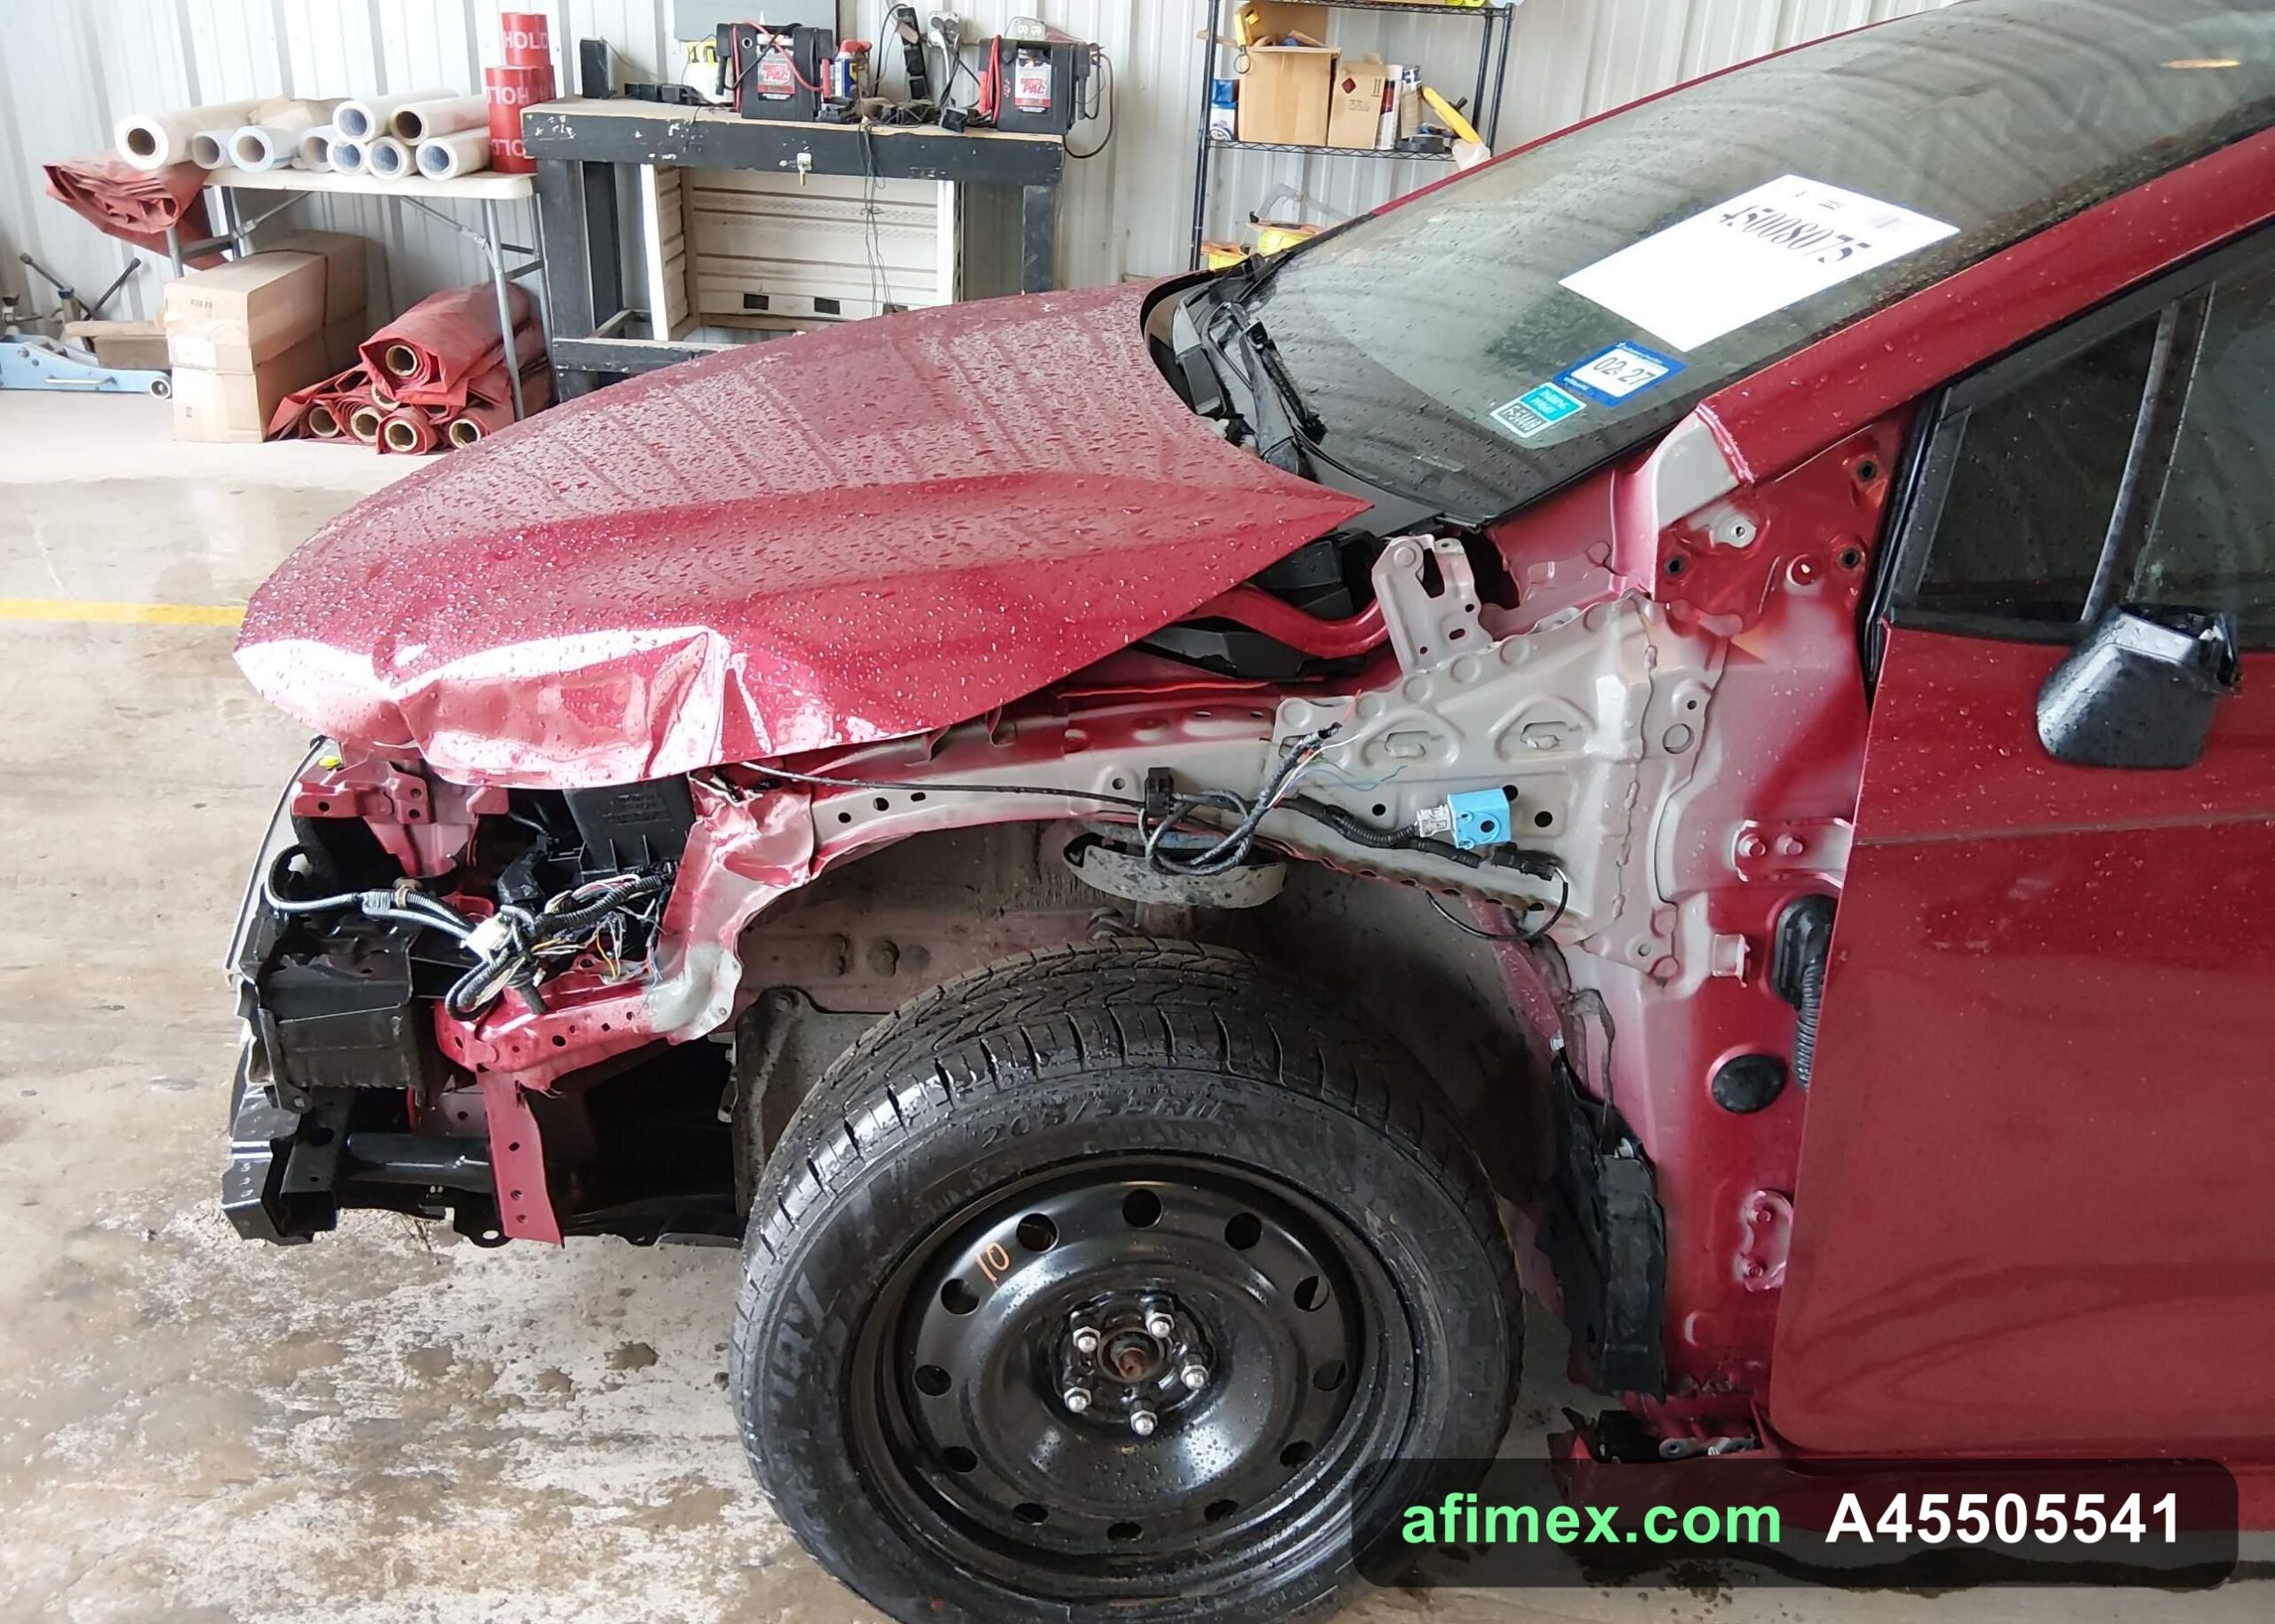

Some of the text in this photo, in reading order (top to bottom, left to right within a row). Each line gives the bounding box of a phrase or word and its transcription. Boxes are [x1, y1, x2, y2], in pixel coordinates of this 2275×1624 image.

[1719, 204, 1872, 263] 45008075
[1593, 356, 1656, 386] 02 27
[975, 1243, 1010, 1282] 10
